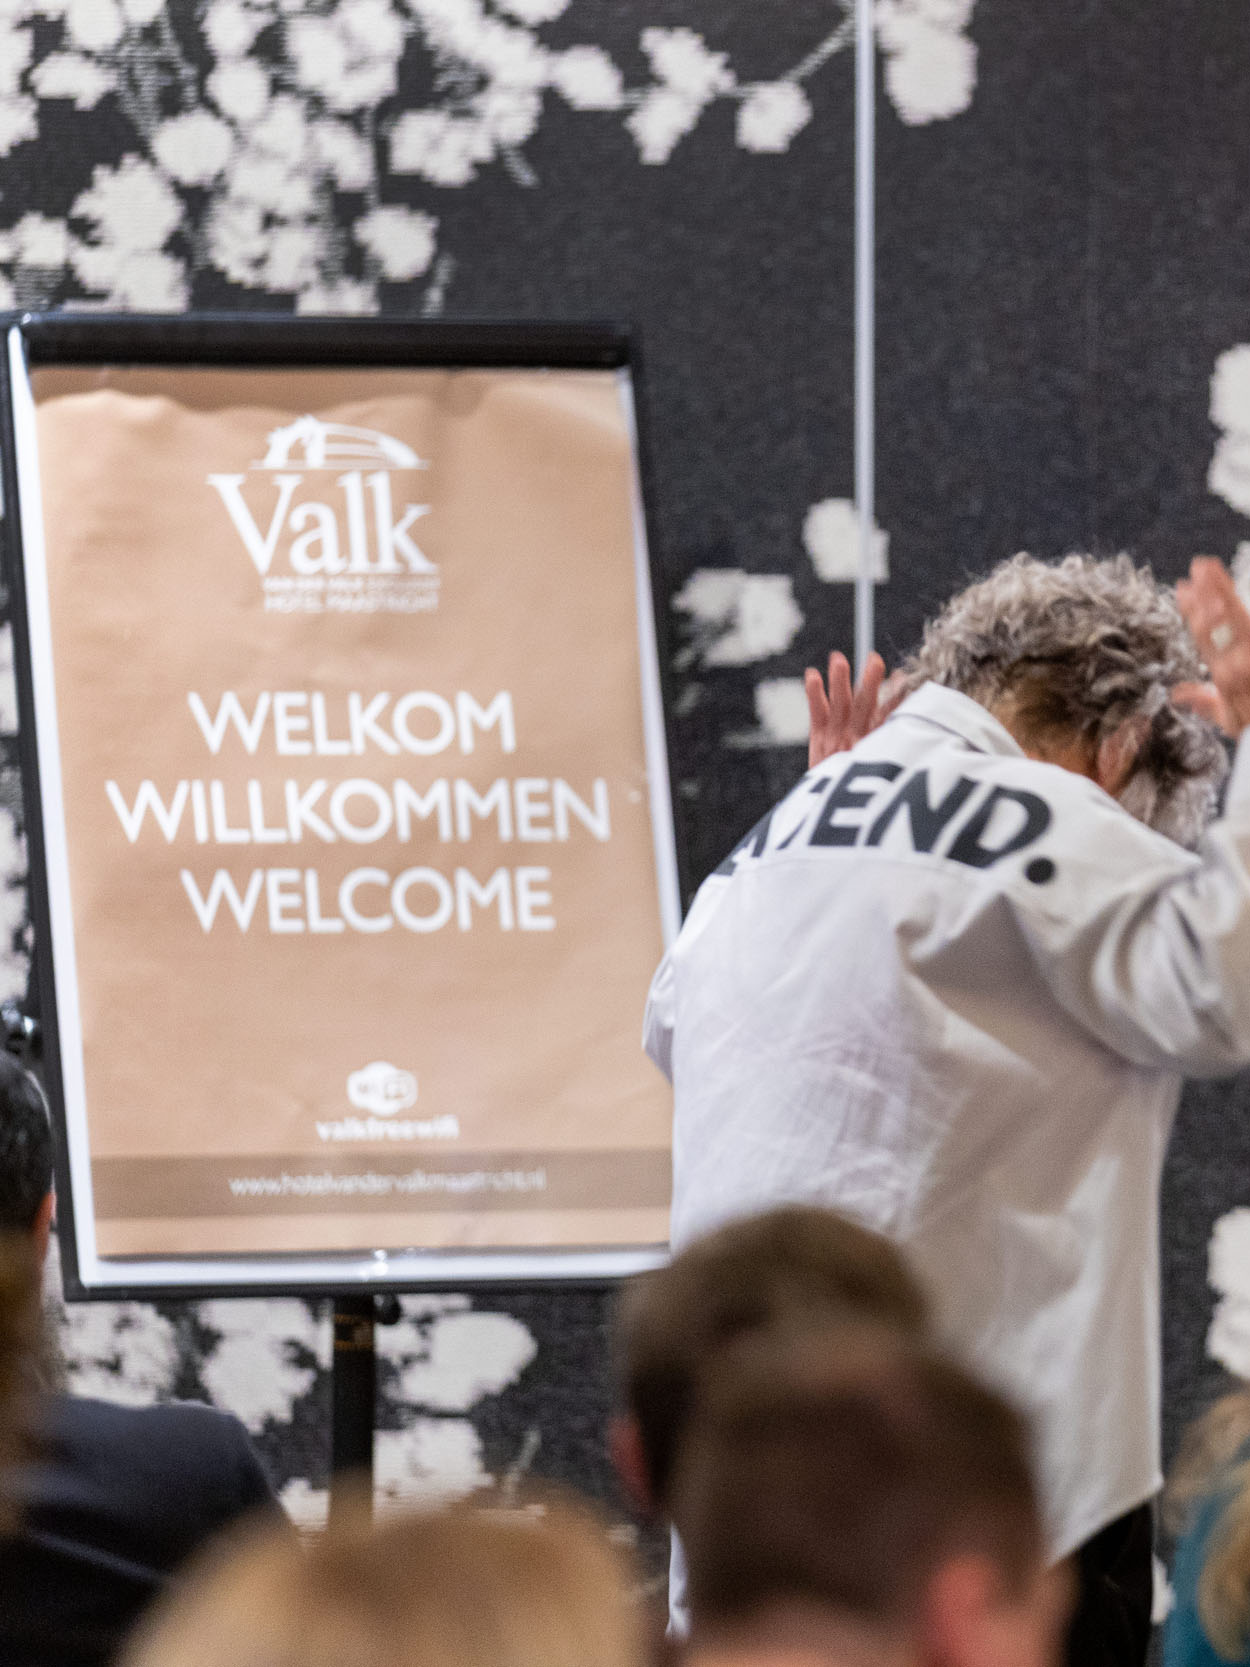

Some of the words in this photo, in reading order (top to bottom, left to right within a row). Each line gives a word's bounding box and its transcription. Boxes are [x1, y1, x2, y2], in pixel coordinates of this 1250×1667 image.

[206, 470, 439, 577] Valk
[187, 690, 517, 755] WELKOM
[104, 777, 612, 844] WILLKOMMEN
[180, 866, 556, 934] WELCOME
